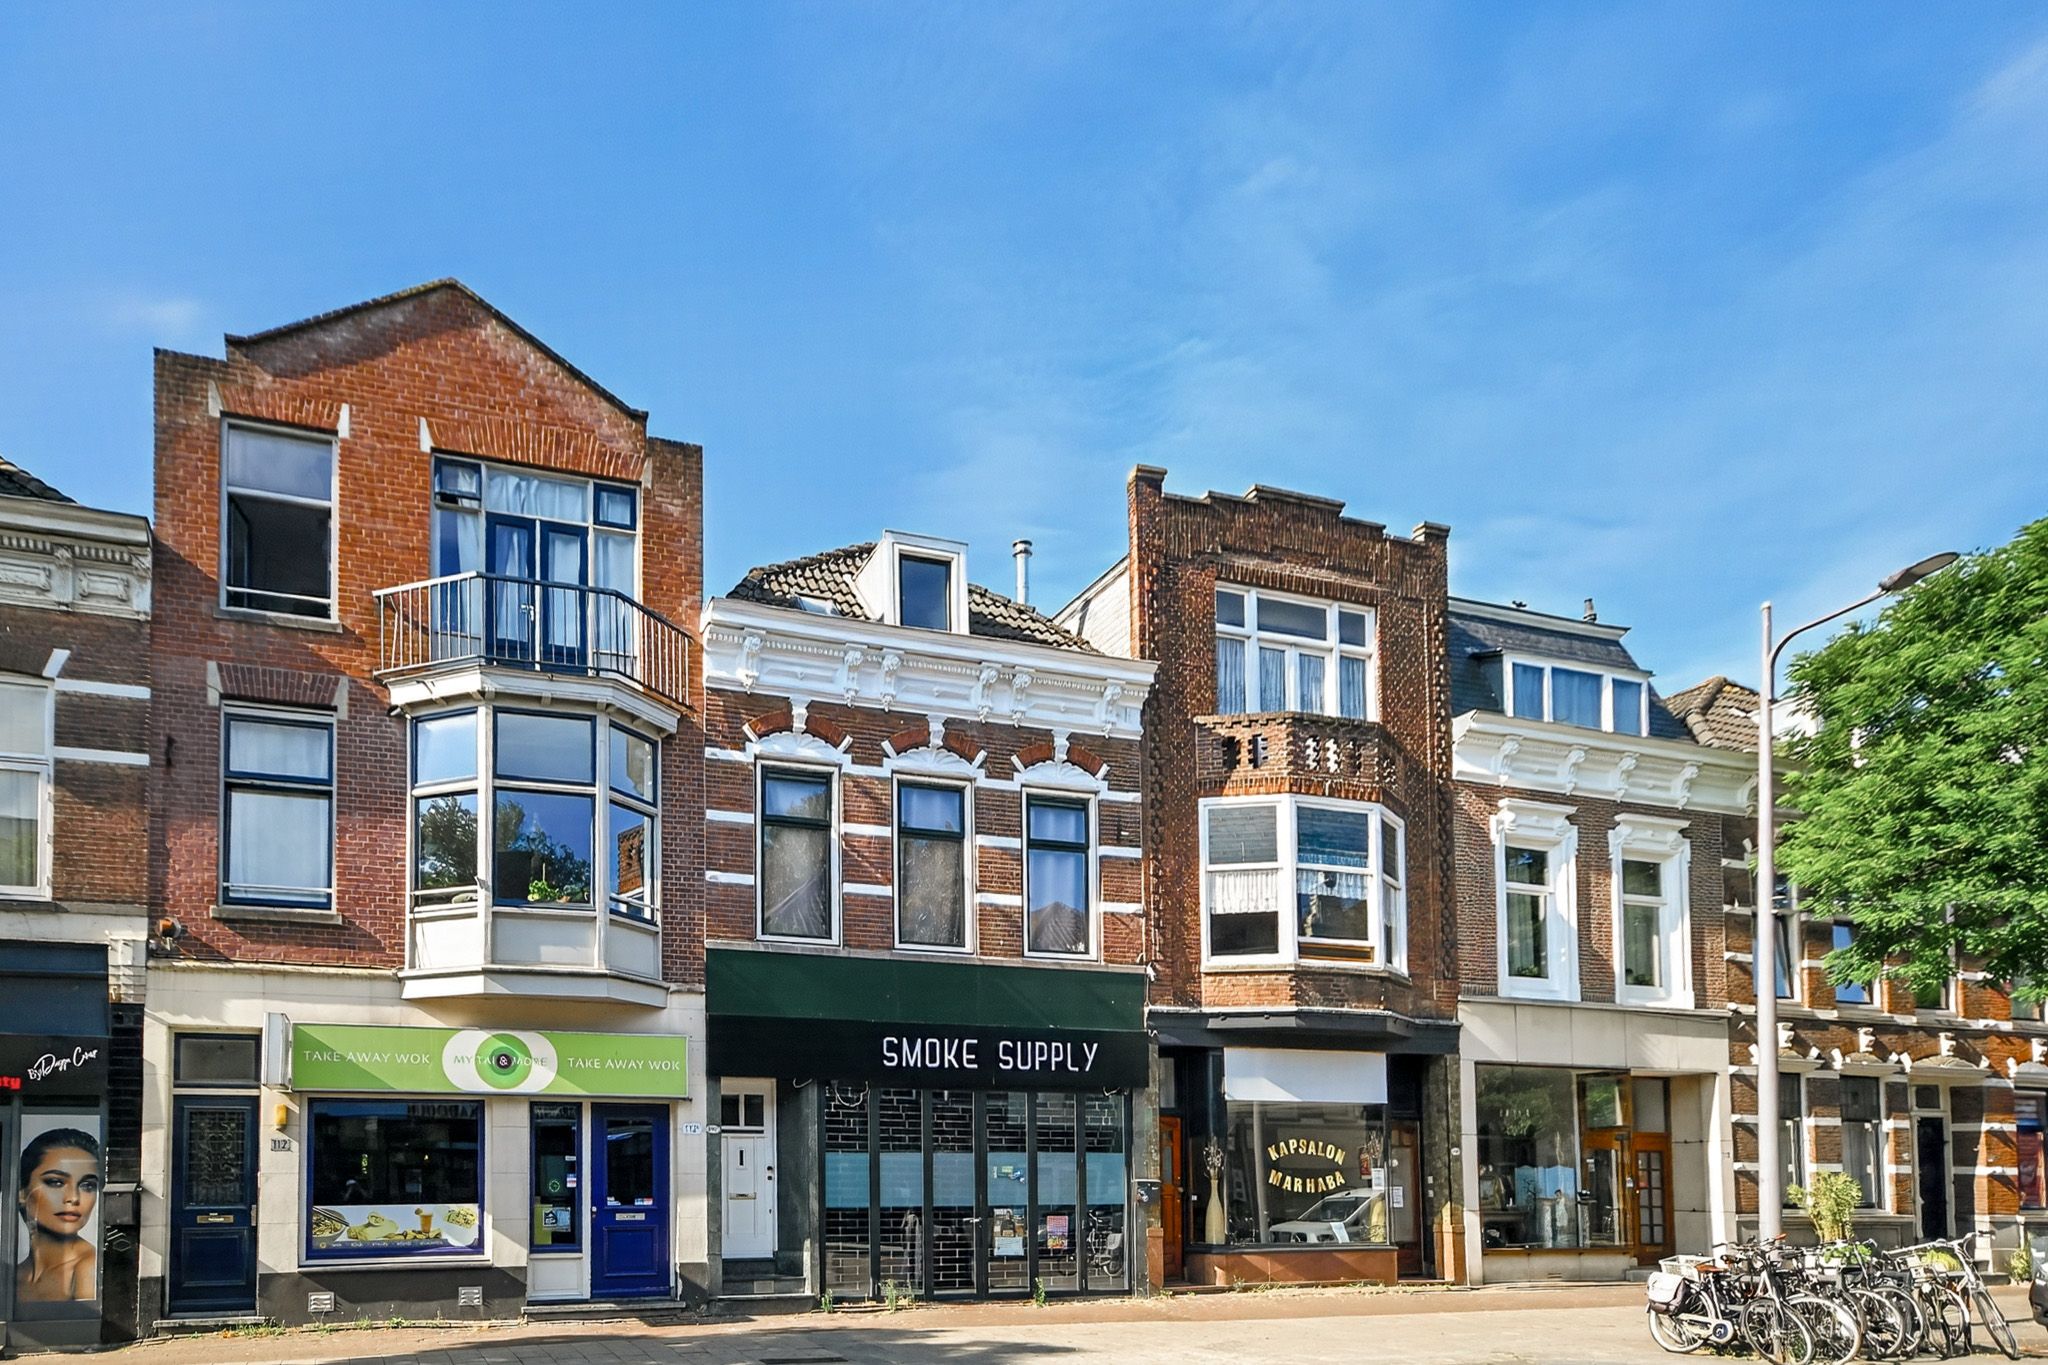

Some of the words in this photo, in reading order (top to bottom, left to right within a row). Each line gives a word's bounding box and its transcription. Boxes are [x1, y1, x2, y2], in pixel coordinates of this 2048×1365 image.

[303, 1050, 341, 1062] TAKE
[345, 1051, 391, 1063] AWAY
[395, 1053, 431, 1064] WOK
[453, 1055, 473, 1064] MY
[499, 1055, 509, 1067] &
[512, 1056, 548, 1067] MORE
[882, 1036, 978, 1069] SMOKE
[998, 1040, 1098, 1072] SUPPLY
[567, 1057, 601, 1069] TAKE
[604, 1058, 644, 1070] AWAY
[648, 1060, 681, 1071] WOK
[272, 1139, 288, 1150] 112
[1267, 1138, 1346, 1166] KAPSALON
[1267, 1169, 1346, 1193] MARHABA
